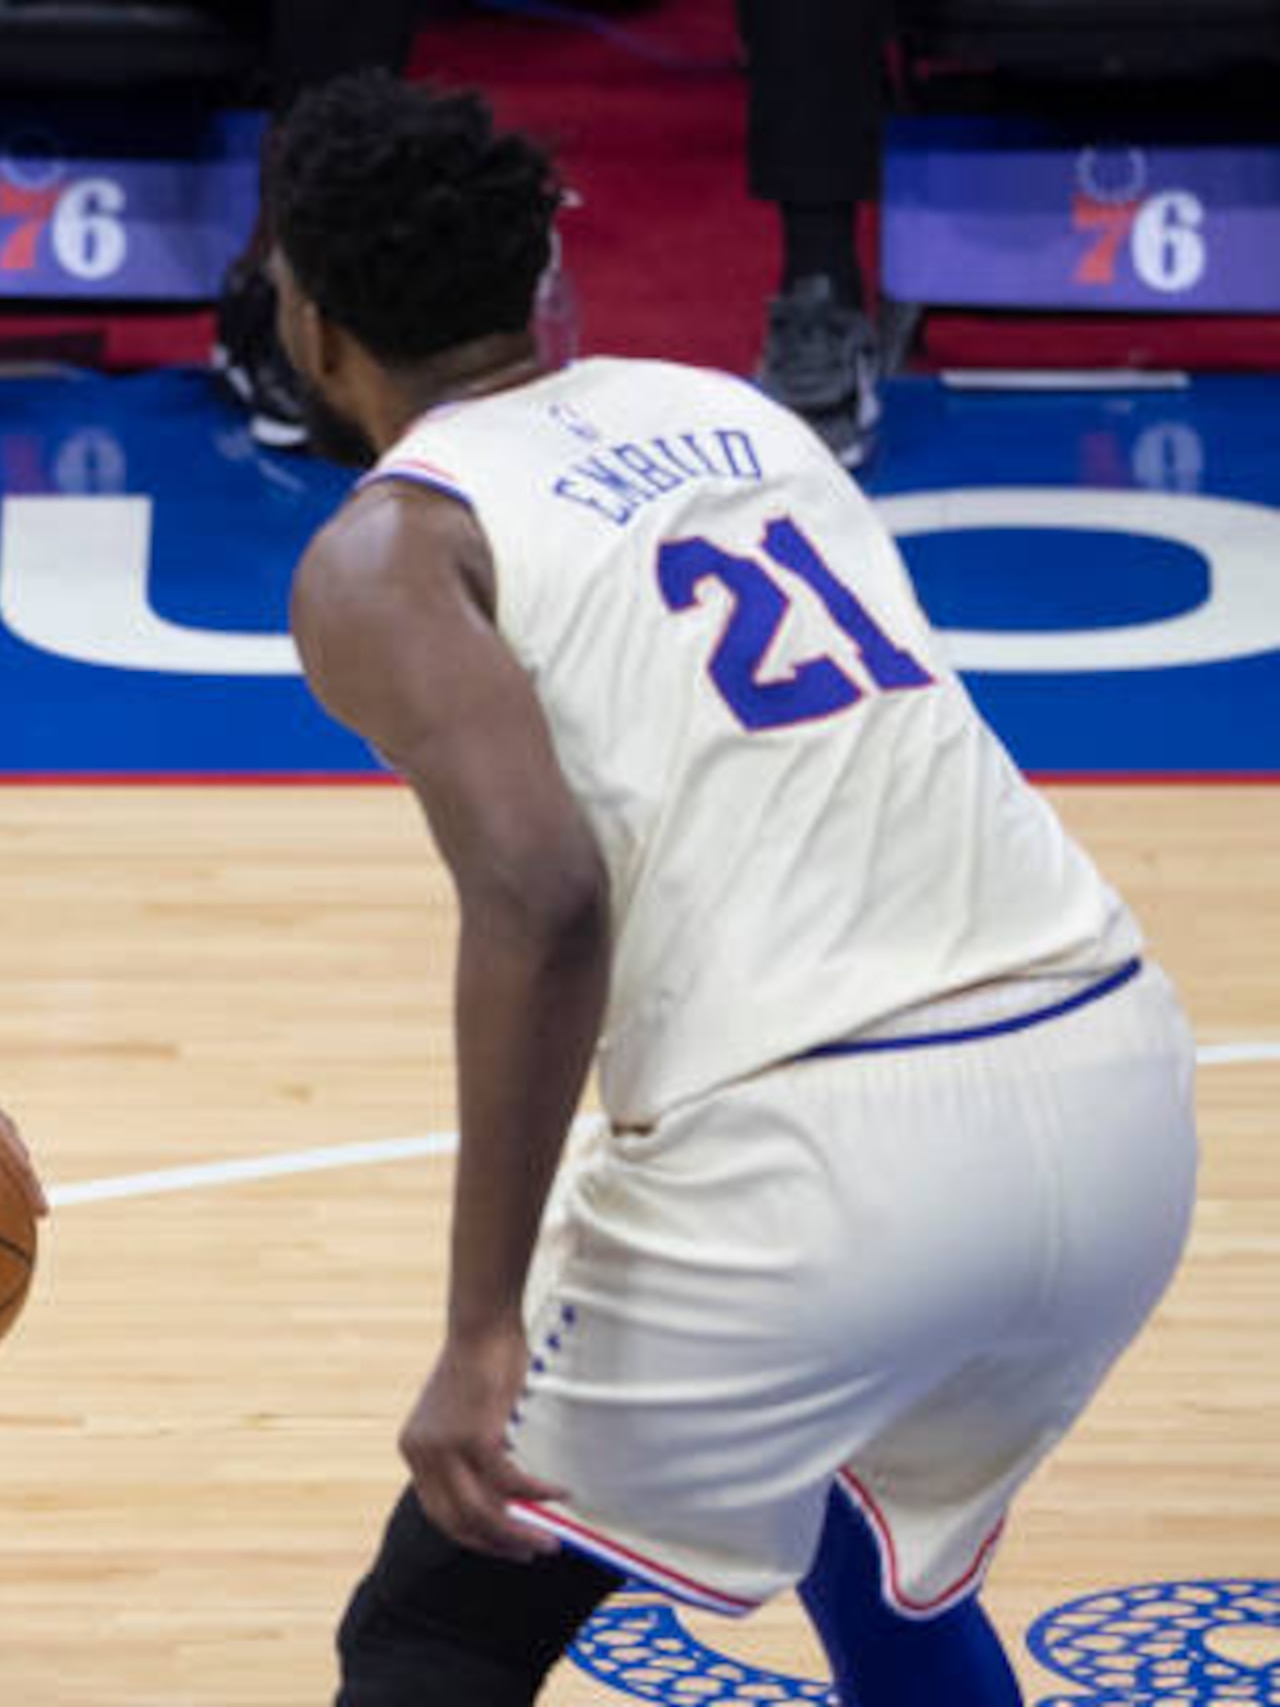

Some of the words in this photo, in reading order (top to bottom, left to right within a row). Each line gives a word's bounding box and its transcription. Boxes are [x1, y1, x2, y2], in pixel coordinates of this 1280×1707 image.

[1070, 189, 1205, 293] 76
[553, 428, 763, 526] EMBIID
[655, 514, 942, 734] 21
